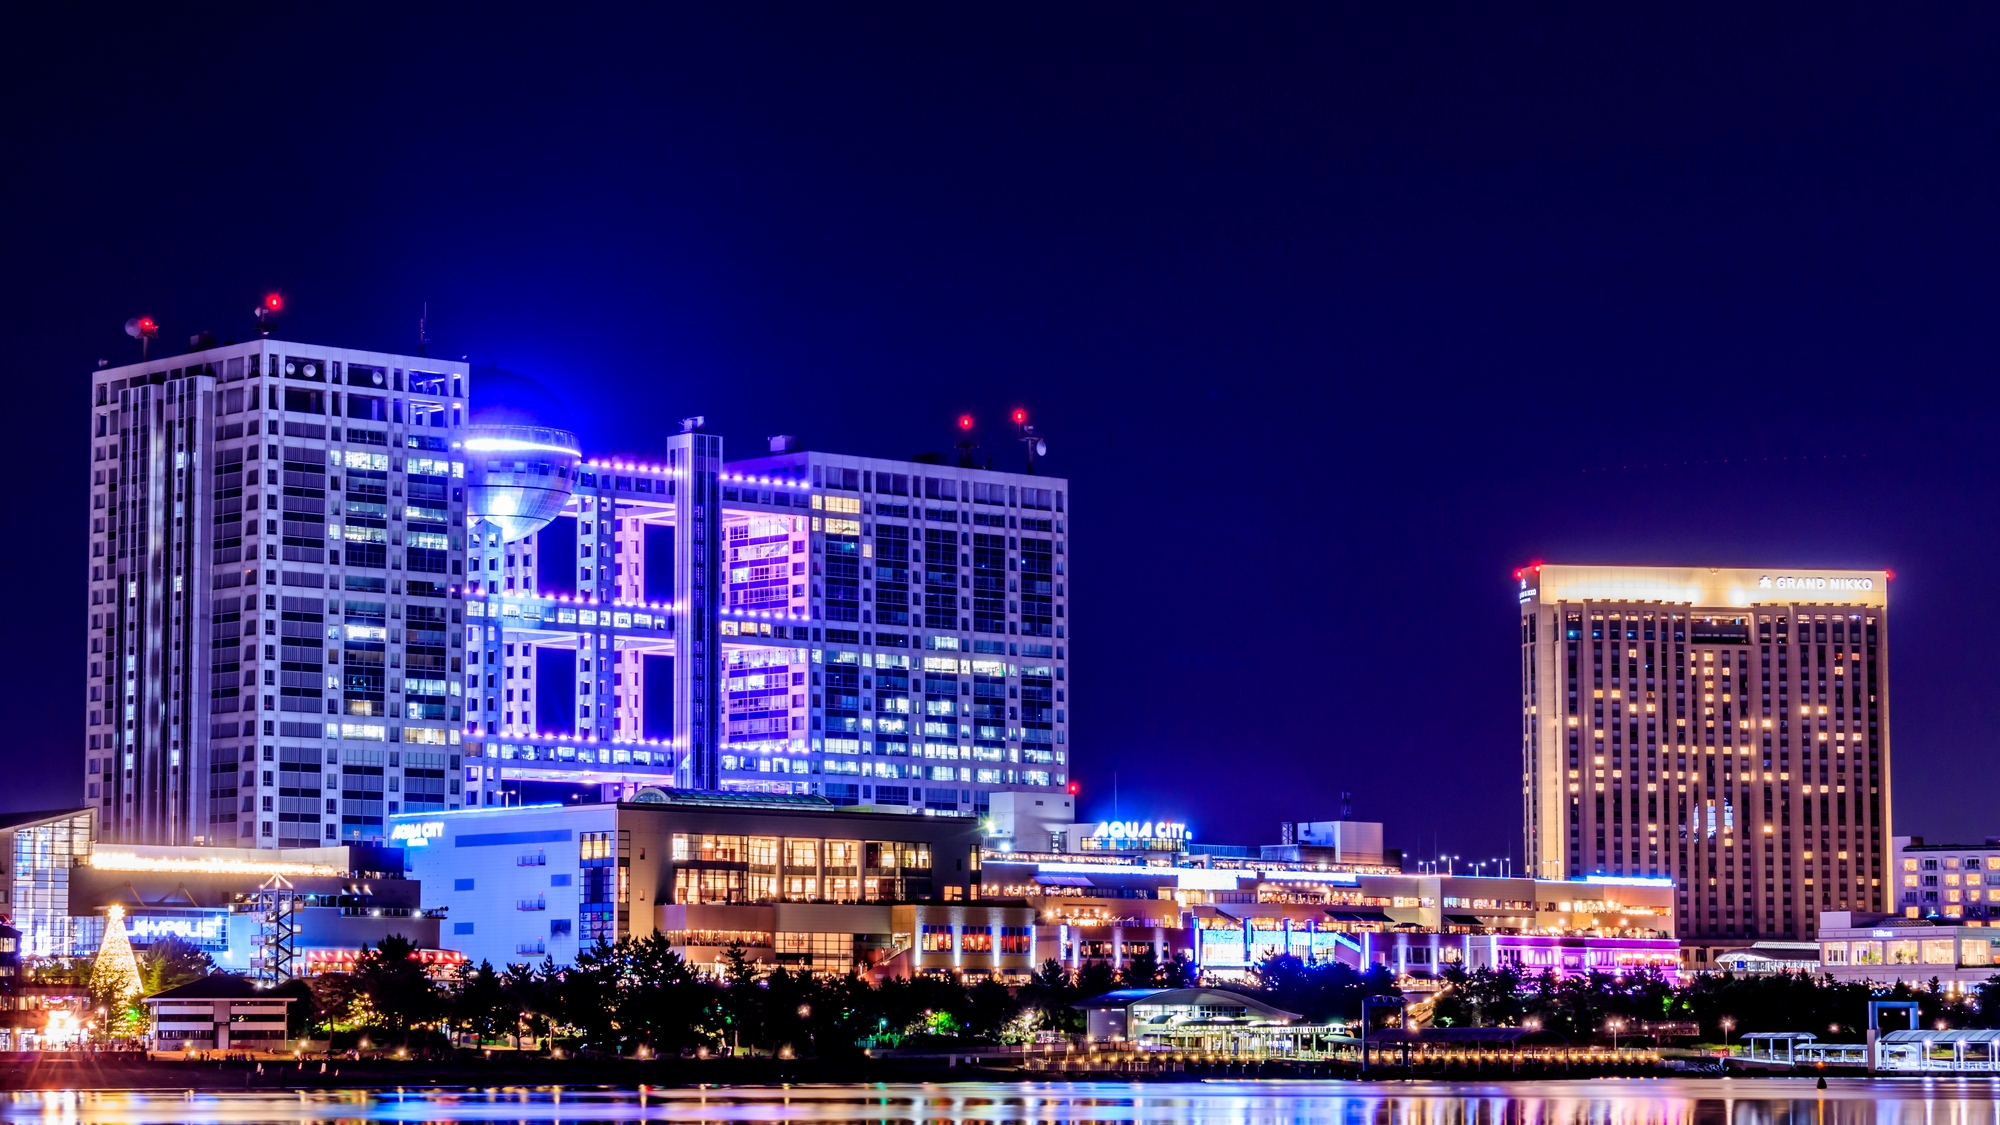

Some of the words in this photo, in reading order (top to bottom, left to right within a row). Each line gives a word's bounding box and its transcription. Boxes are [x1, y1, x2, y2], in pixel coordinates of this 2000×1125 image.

[1776, 576, 1826, 590] GRAND
[1829, 577, 1873, 591] NIKKO
[391, 823, 421, 840] AQUA
[1093, 821, 1152, 838] AQUA
[1873, 929, 1893, 938] Hilton
